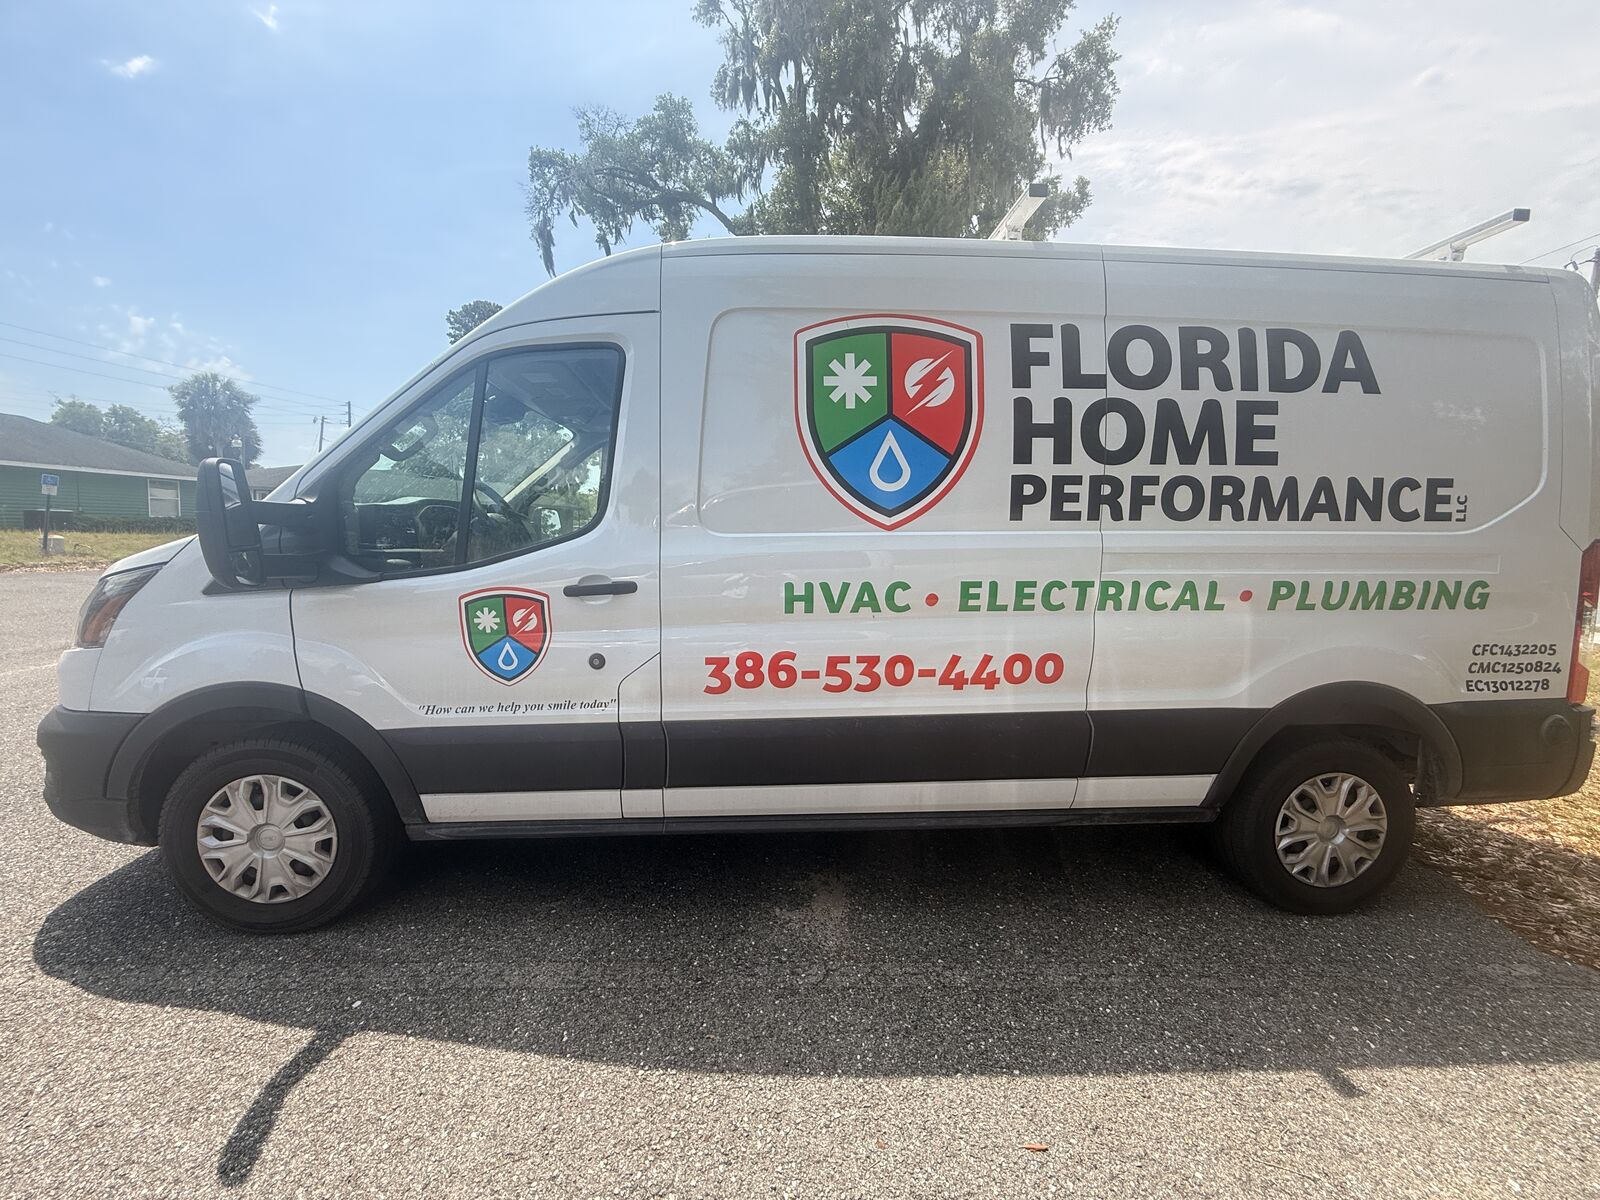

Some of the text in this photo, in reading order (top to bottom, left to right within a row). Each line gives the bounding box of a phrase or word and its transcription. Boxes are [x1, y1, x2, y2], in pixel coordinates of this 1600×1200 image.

[1010, 323, 1381, 394] FLORIDA
[1012, 396, 1279, 467] HOME
[1009, 474, 1454, 523] PERFORMANCE
[1455, 495, 1467, 522] LLC
[784, 579, 1490, 614] HVAC ELECTRICAL PLUMBING
[1472, 643, 1557, 656] CFC1432205
[704, 651, 1064, 695] 386-530-4400
[1468, 660, 1562, 674] CMC1250824
[1465, 678, 1550, 693] EC13012278
[455, 705, 475, 714] can
[479, 705, 494, 713] we
[497, 701, 521, 714] help
[522, 703, 544, 714] you
[547, 699, 577, 711] smile
